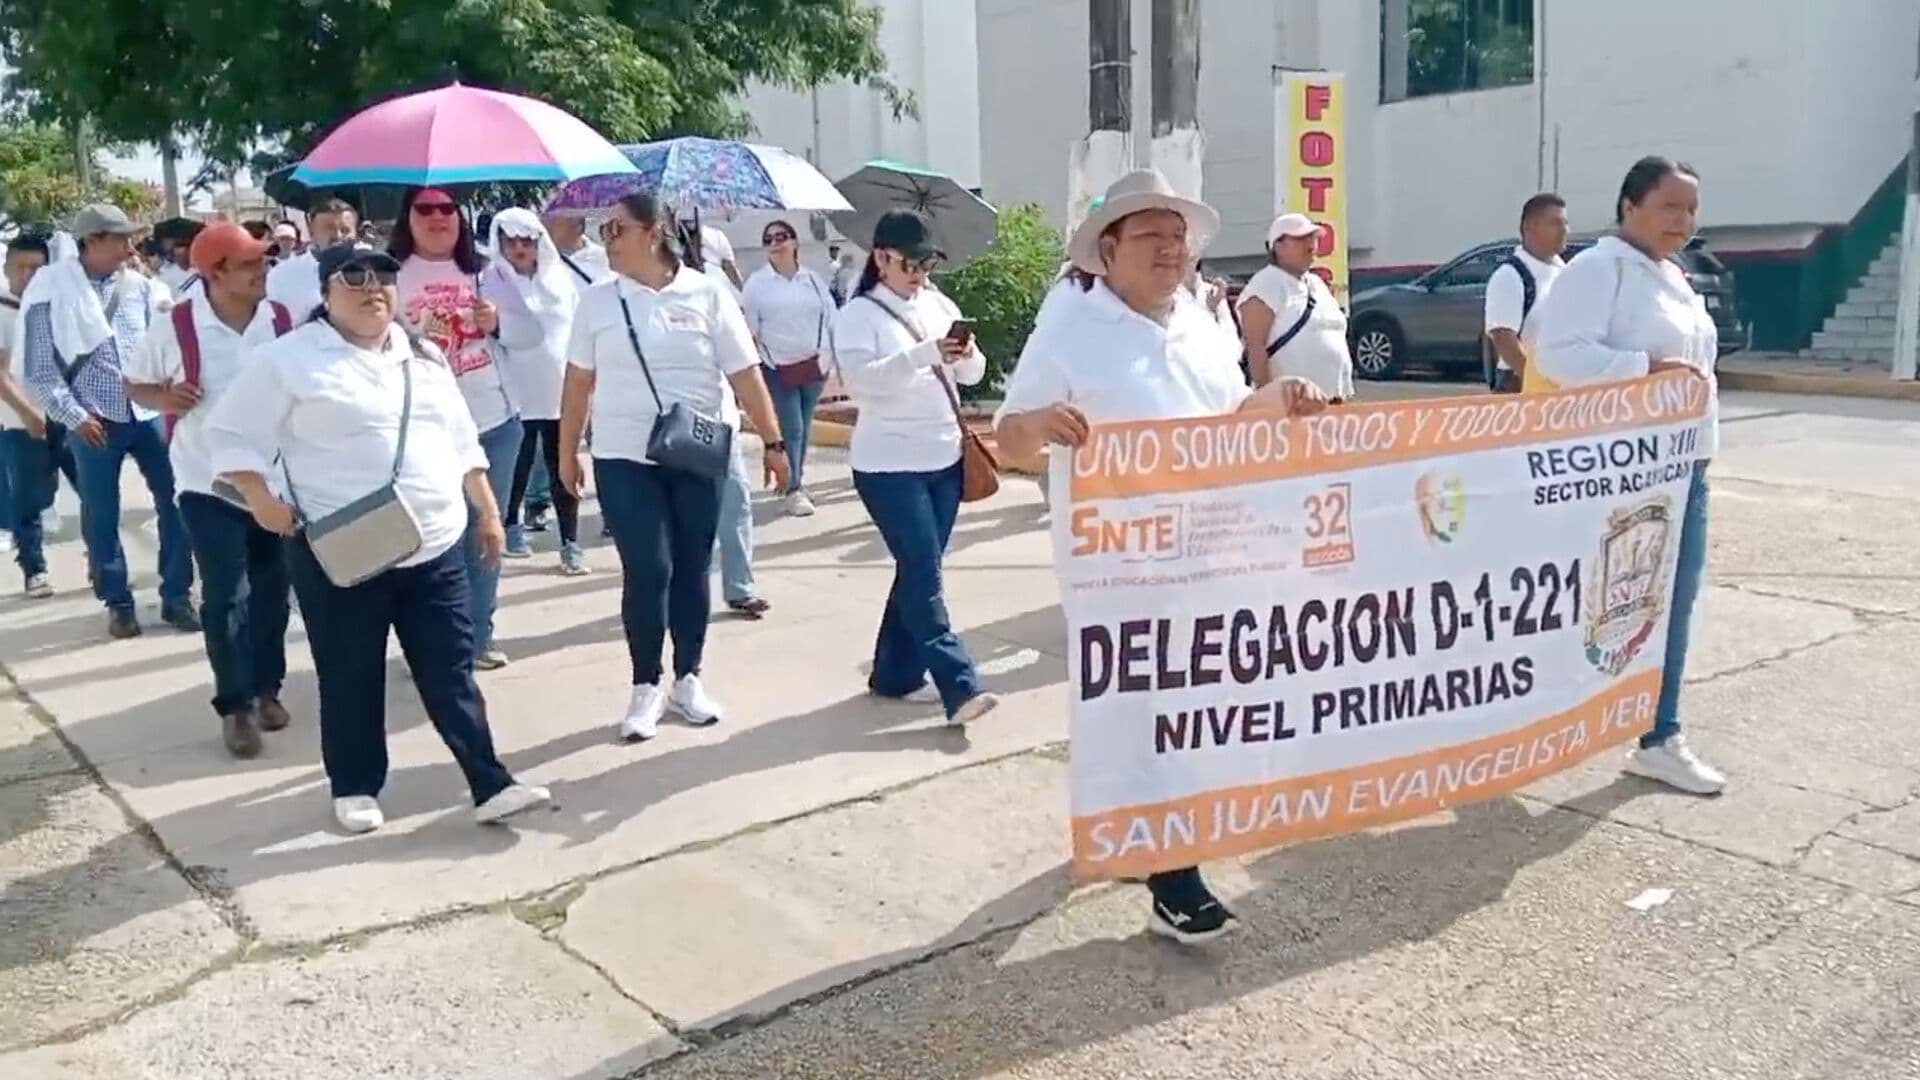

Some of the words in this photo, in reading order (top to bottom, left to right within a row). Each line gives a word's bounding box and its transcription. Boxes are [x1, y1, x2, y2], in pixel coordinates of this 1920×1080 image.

[1074, 427, 1161, 478] UNO
[1171, 417, 1291, 472] SOMOS
[1301, 411, 1403, 459] TODOS
[1408, 408, 1433, 446] Y
[1433, 400, 1535, 445] TODOS
[1532, 382, 1636, 432] SOMOS
[1643, 375, 1703, 418] UNO
[1527, 434, 1659, 479] REGION
[1304, 492, 1347, 538] 32
[1534, 478, 1613, 505] SECTOR
[1619, 461, 1691, 495] ACCAN
[1071, 508, 1174, 557] SNTE
[1081, 589, 1416, 701] DELEGACION
[1431, 558, 1581, 650] D-1-221
[1155, 701, 1295, 753] NIVEL
[1312, 656, 1534, 734] PRIMARIAS
[1086, 808, 1197, 861] SAN
[1209, 785, 1334, 842] JUAN
[1348, 719, 1590, 814] EVANGELISTA,
